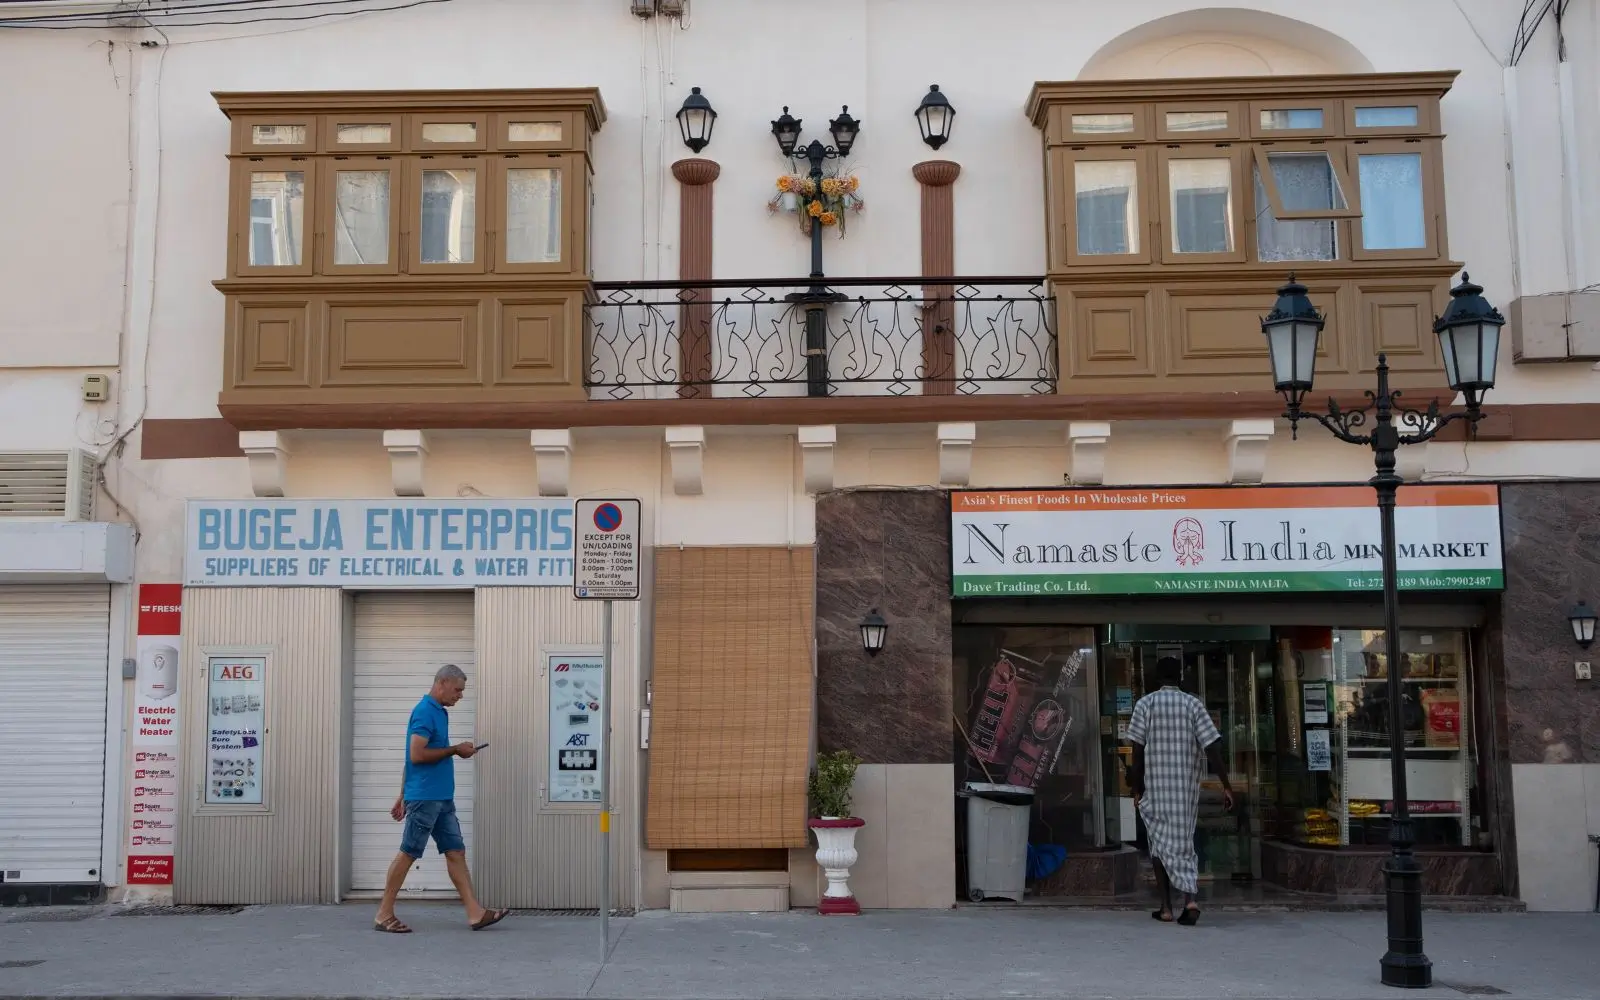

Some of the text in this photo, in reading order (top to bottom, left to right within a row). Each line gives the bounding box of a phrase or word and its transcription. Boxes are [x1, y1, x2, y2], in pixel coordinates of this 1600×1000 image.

[960, 493, 1186, 506] Asia's Finest Foods In Wholesale Prices
[198, 508, 572, 551] BUGEJA ENTERPRIS
[961, 520, 1489, 564] Namaste India MIN MARKET
[205, 558, 298, 576] SUPPLIERS
[308, 558, 330, 576] OF
[340, 558, 444, 576] ELECTRICAL
[452, 558, 464, 576] &
[475, 558, 528, 576] WATER
[963, 580, 1090, 594] Dave Trading Co. Ltd.
[1154, 579, 1288, 590] NAMASTE INDIA MALTA
[1346, 578, 1365, 587] Tel:
[220, 666, 253, 679] AEG
[566, 733, 590, 746] A&T
